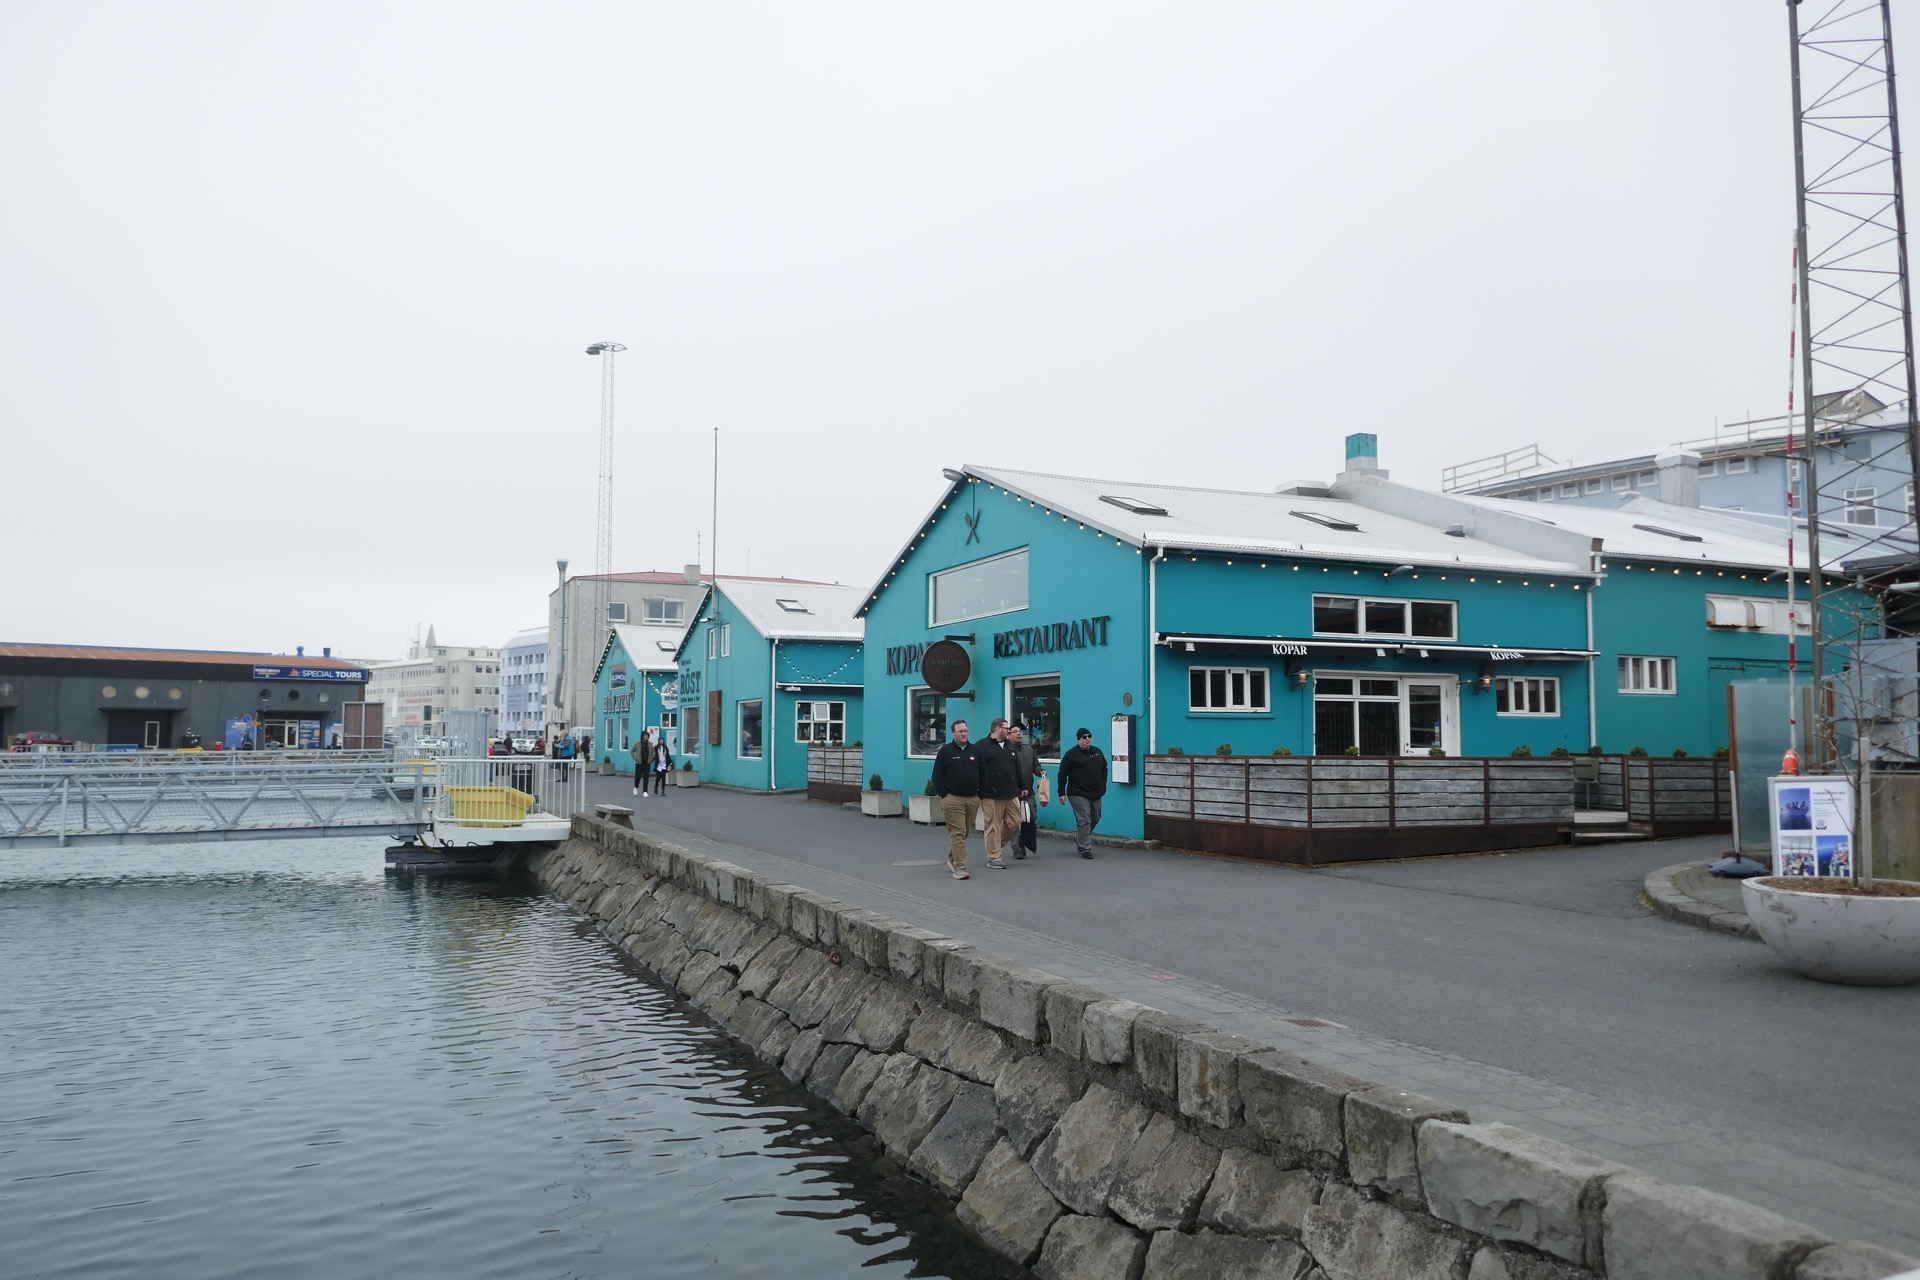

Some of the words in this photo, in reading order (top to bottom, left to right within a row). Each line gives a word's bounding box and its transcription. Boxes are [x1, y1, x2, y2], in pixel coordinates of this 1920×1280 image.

[886, 640, 934, 676] KOPA
[993, 615, 1111, 659] RESTAURANT
[1272, 644, 1308, 655] KOPAR
[302, 670, 333, 678] SPECIAL
[335, 670, 362, 679] TOURS
